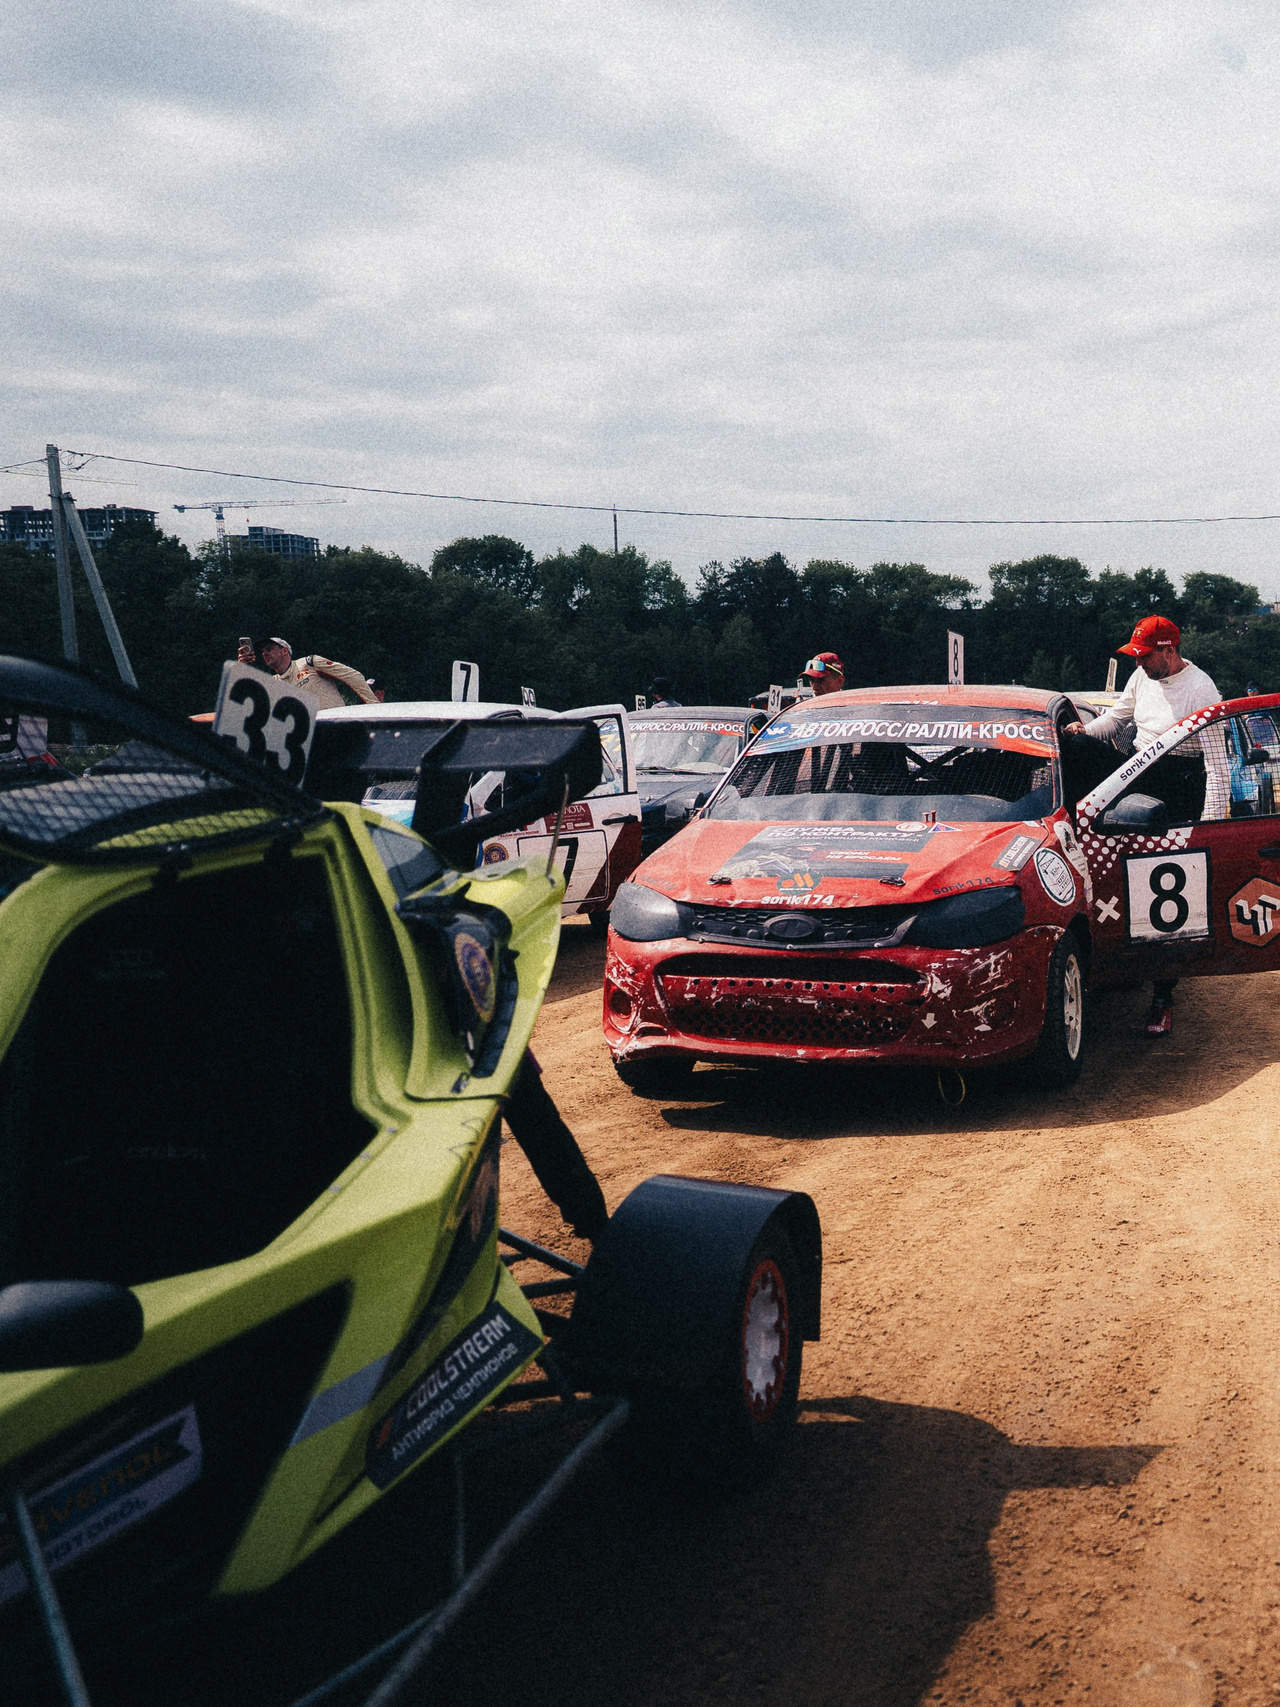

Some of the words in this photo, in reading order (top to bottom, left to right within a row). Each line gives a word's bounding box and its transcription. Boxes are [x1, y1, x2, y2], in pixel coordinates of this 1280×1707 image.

[953, 638, 959, 678] 8
[459, 664, 471, 703] 7
[770, 688, 781, 707] 31
[229, 677, 310, 781] 33
[790, 720, 1046, 741] АВТОКРОСС/РАЛЛИ-КРОСС
[1119, 740, 1165, 781] sorik174
[555, 836, 579, 895] 7
[760, 894, 835, 906] sorik174
[932, 876, 994, 896] sorik174
[1149, 862, 1190, 933] 8
[405, 1313, 512, 1421] COOLSTREAM
[391, 1398, 456, 1461] АНТИФРИЗ
